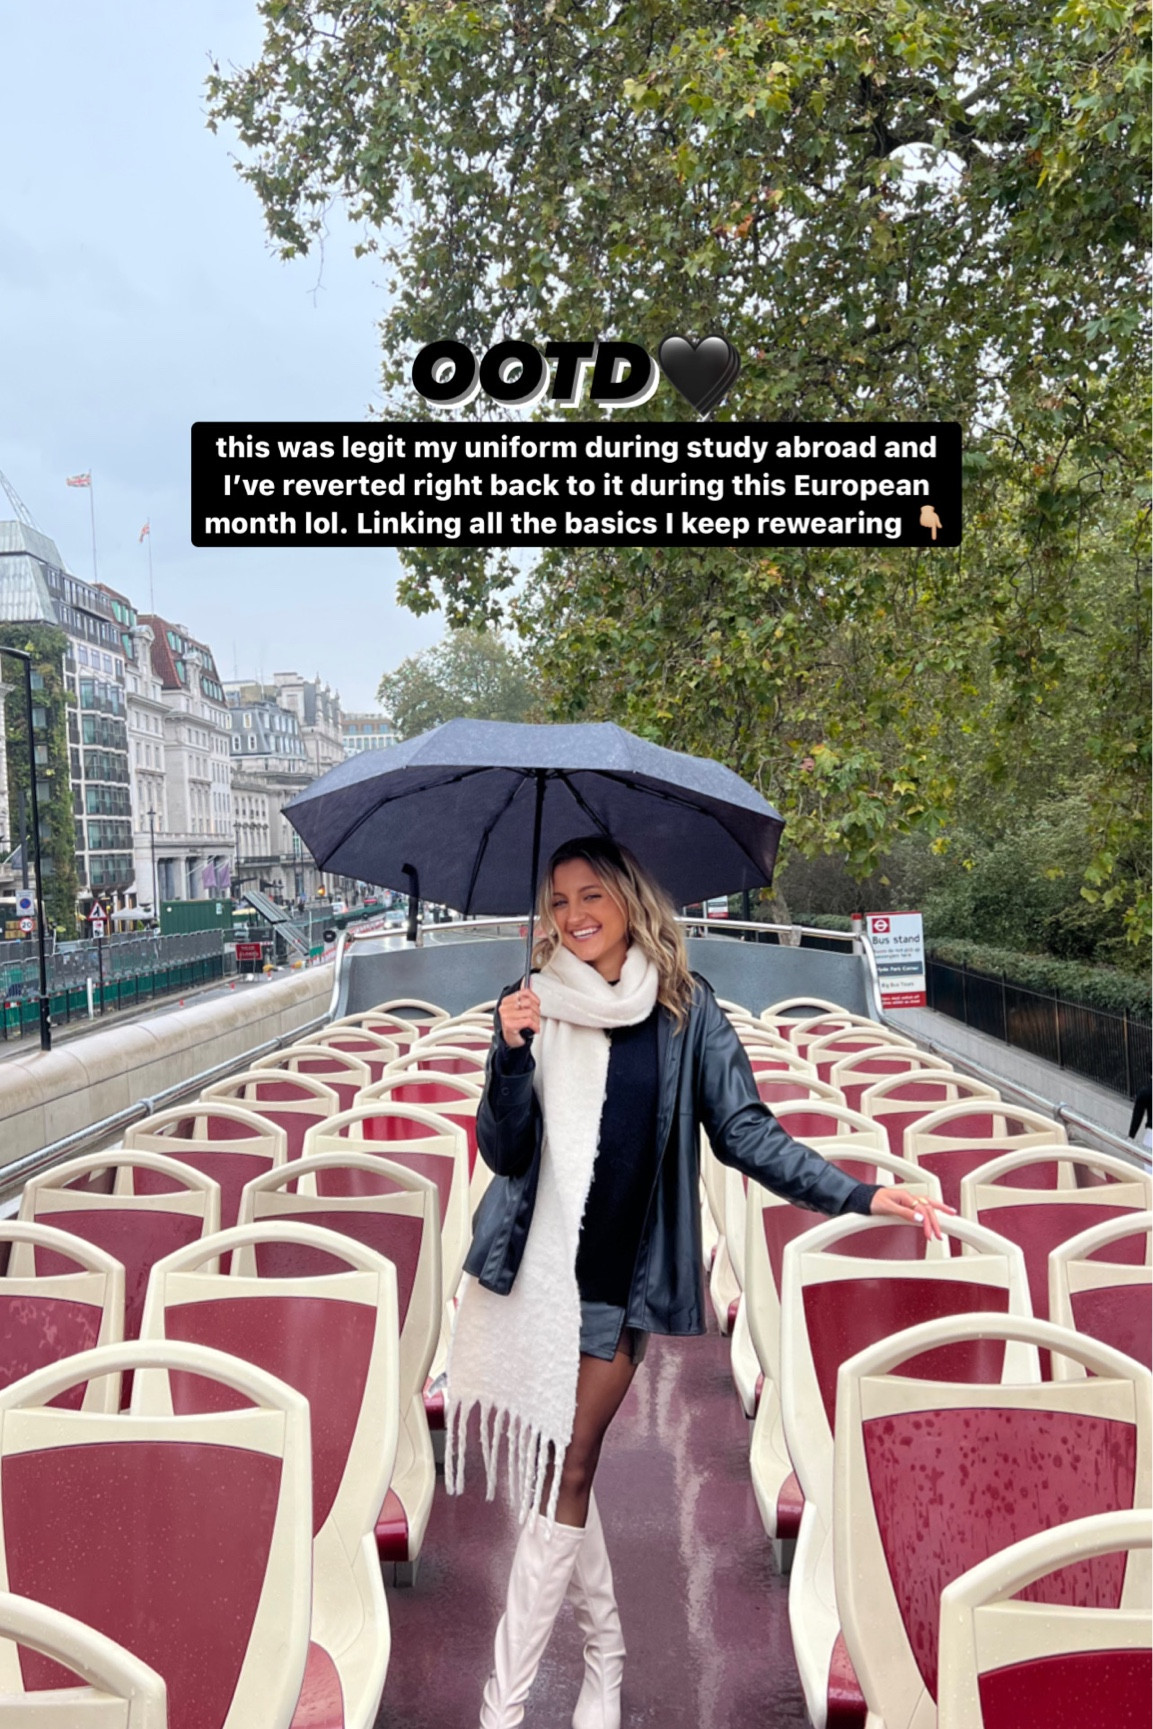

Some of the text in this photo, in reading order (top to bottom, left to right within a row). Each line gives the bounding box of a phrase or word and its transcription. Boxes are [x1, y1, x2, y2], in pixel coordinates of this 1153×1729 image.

[22, 921, 33, 929] 20
[873, 935, 920, 945] Bus stand
